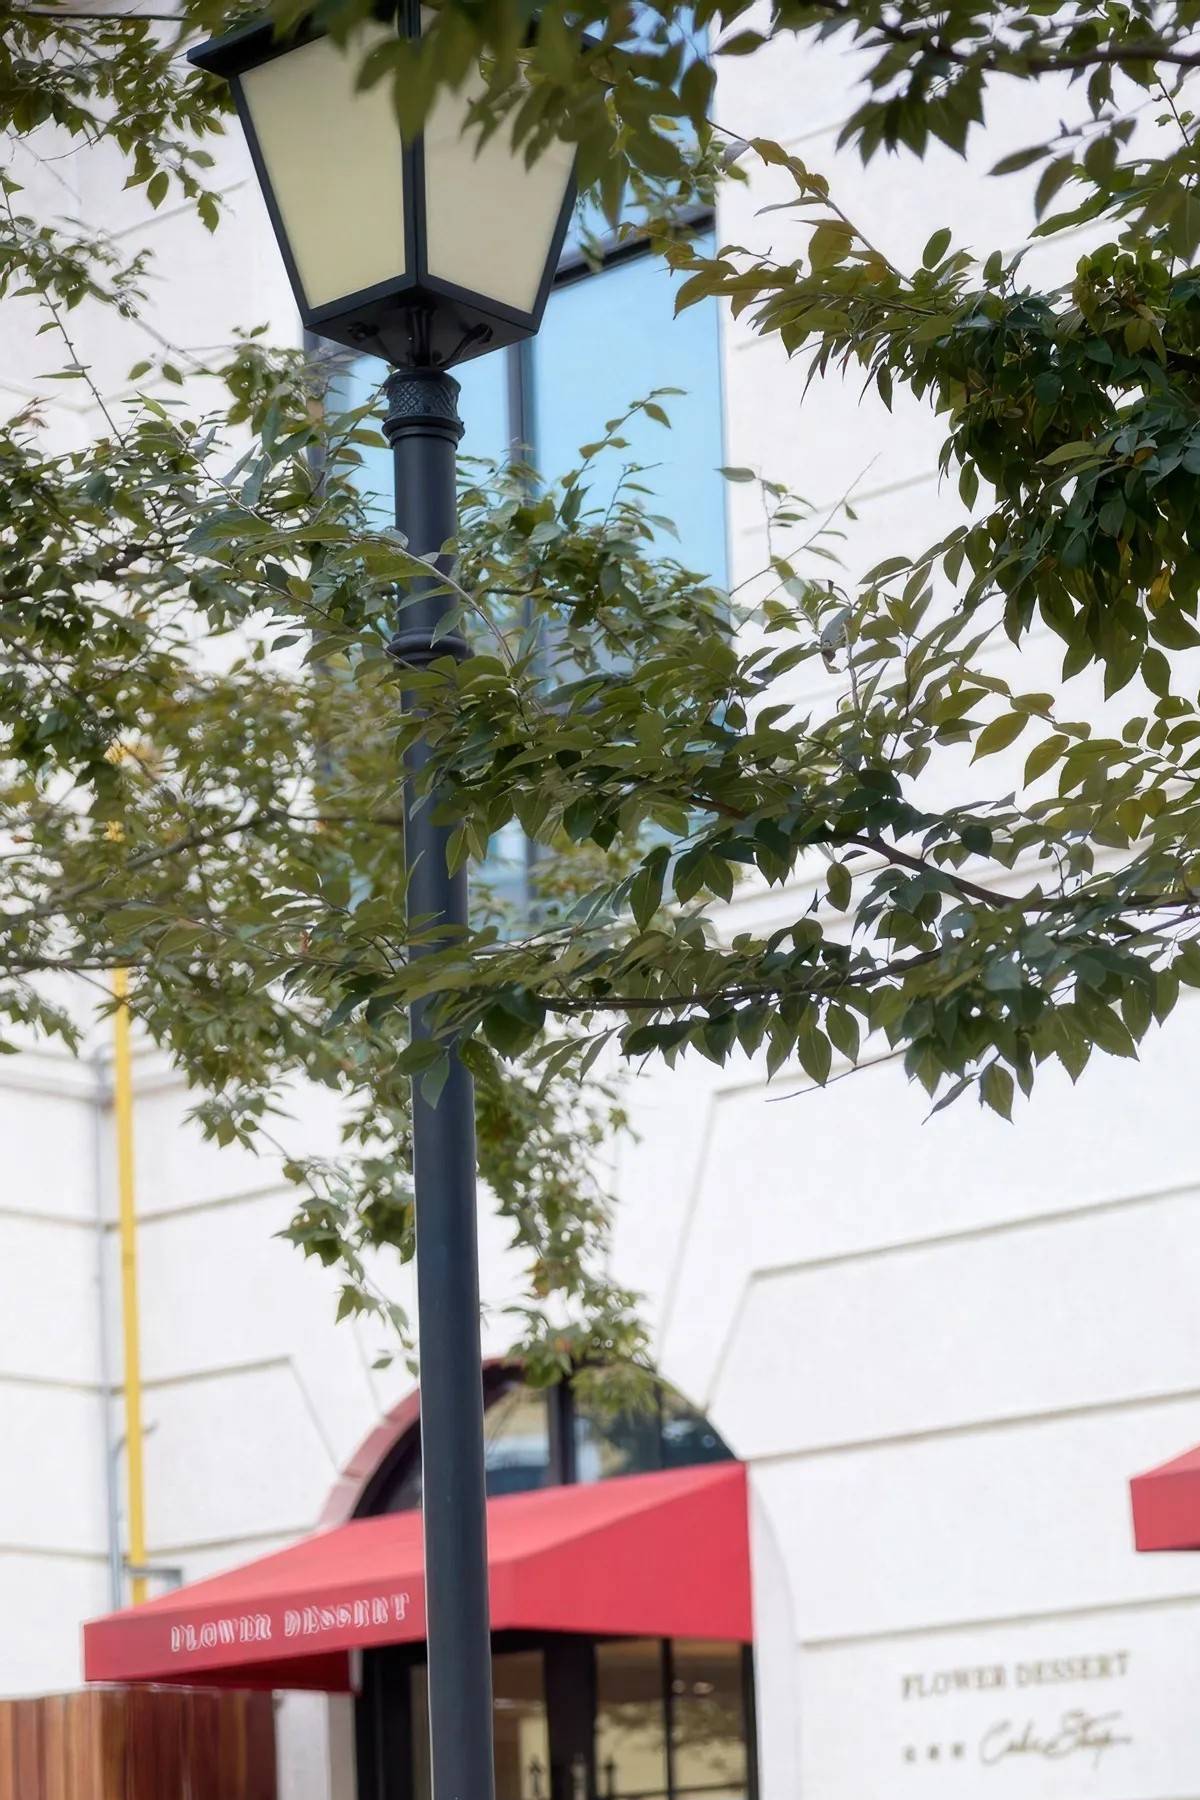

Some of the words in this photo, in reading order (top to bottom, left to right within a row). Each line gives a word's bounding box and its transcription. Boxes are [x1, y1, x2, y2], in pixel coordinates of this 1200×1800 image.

[170, 1613, 272, 1652] FLOWER
[284, 1593, 409, 1638] DESSERT
[902, 1664, 1006, 1700] FLOWER
[1016, 1650, 1130, 1688] DESSERT
